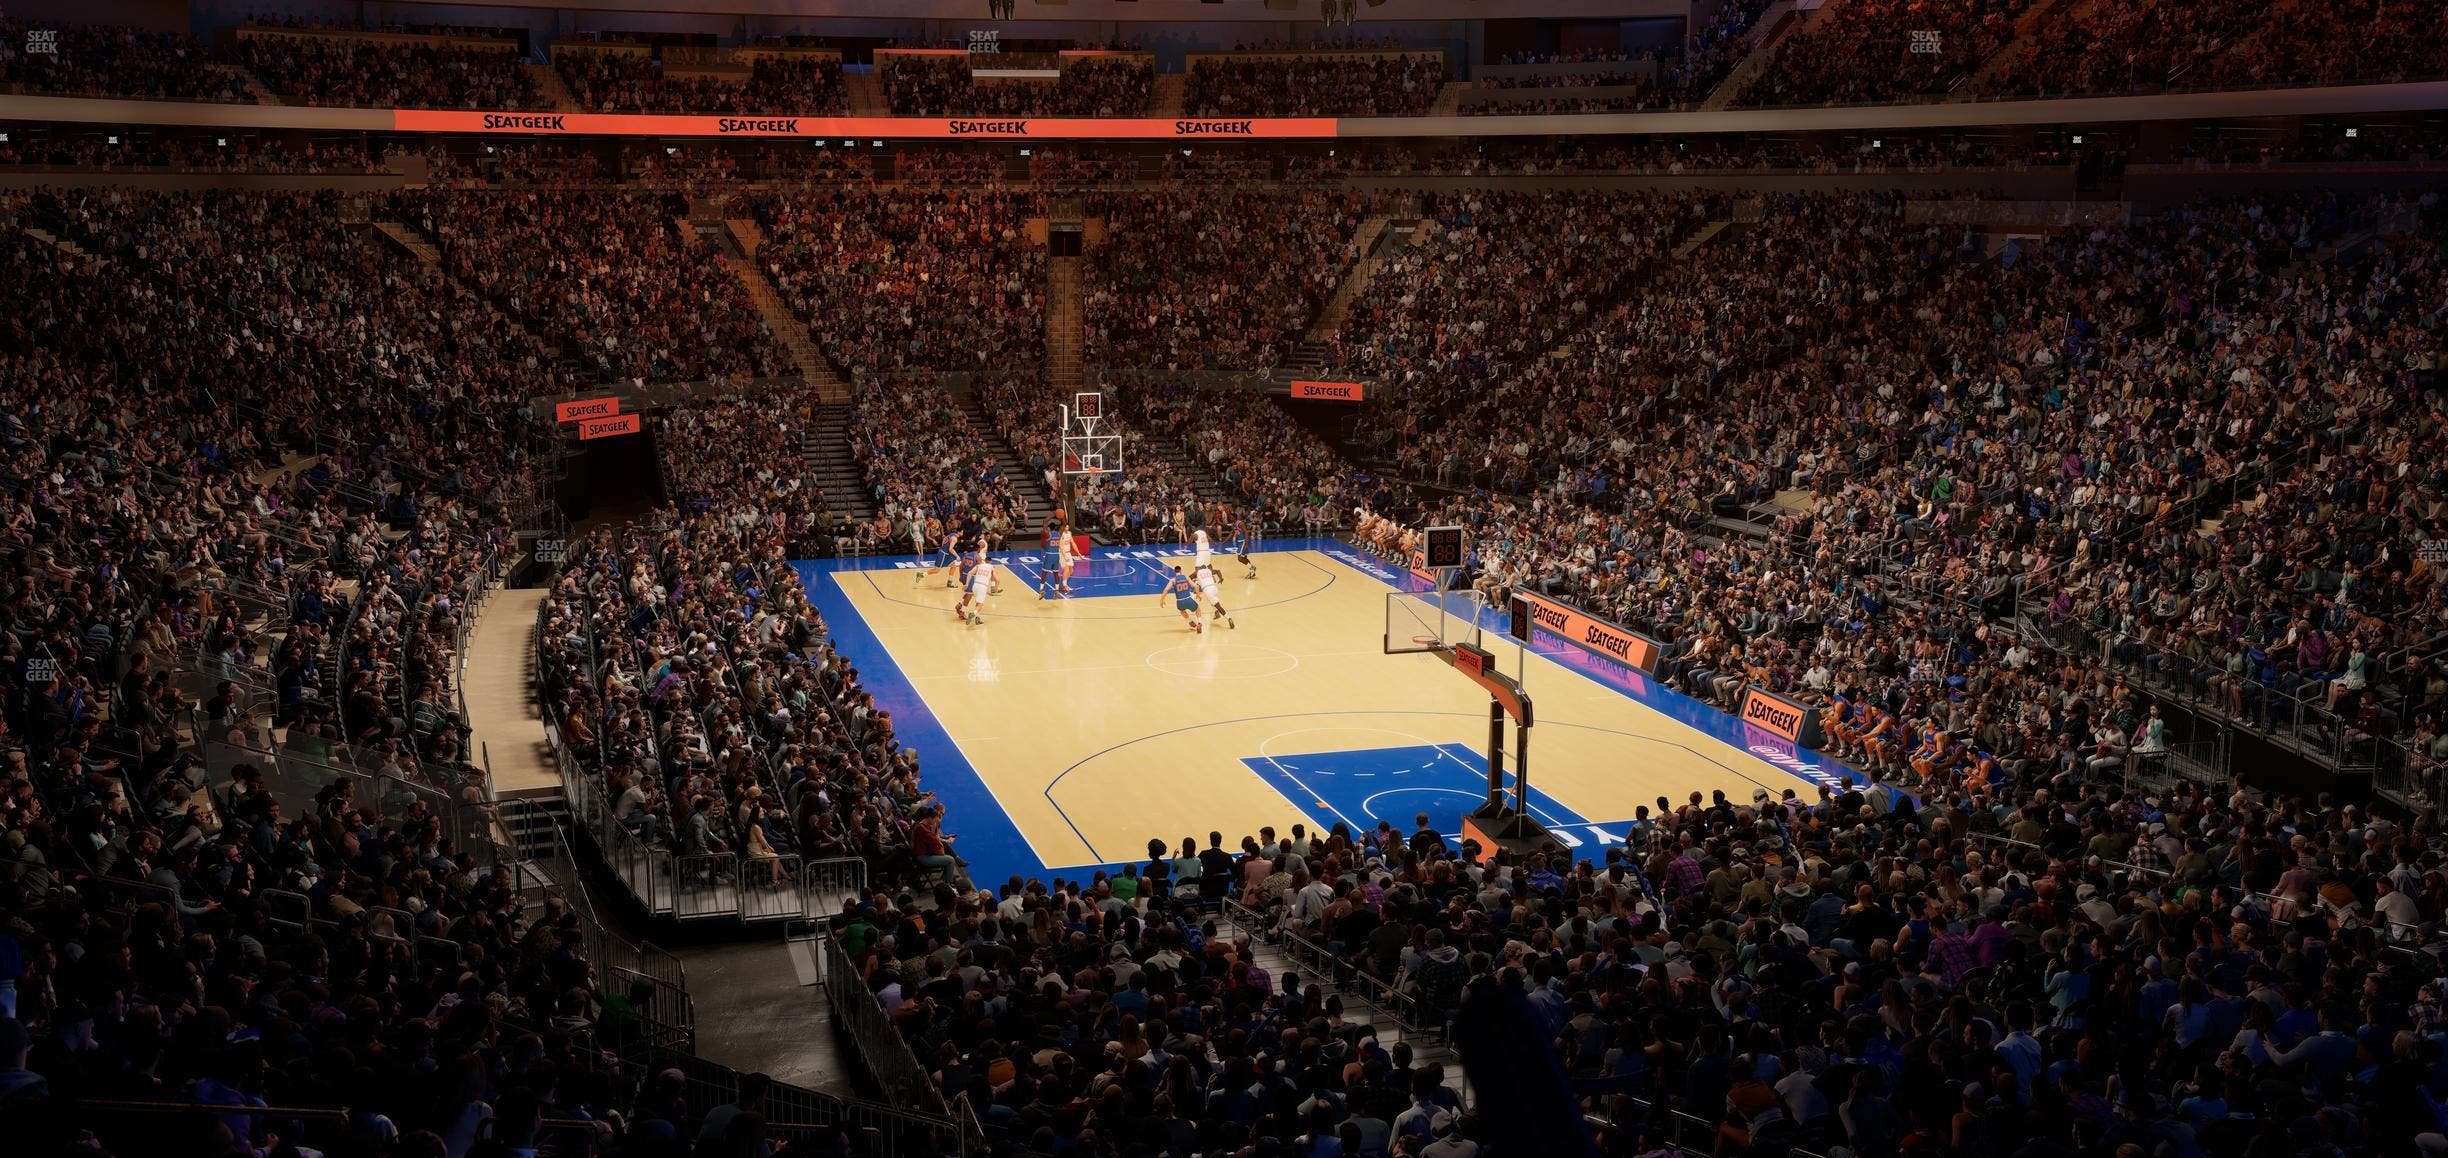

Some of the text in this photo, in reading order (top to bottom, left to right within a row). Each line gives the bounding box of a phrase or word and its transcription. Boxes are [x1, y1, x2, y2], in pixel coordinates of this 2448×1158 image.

[483, 114, 566, 131] SEATGEEK
[718, 118, 799, 134] SEATGEEK
[949, 120, 1028, 135] SEATGEEK
[1175, 120, 1253, 135] SEATGEEK
[1303, 385, 1351, 398] SEATGEEK
[566, 402, 608, 418] SEATGEEK
[589, 420, 630, 436] SEATGEEK
[1532, 601, 1570, 633] EATGEEK
[1585, 625, 1633, 660] SEATGEEK
[1458, 649, 1480, 671] SEATGEEK
[1747, 697, 1800, 736] SEATGEEK
